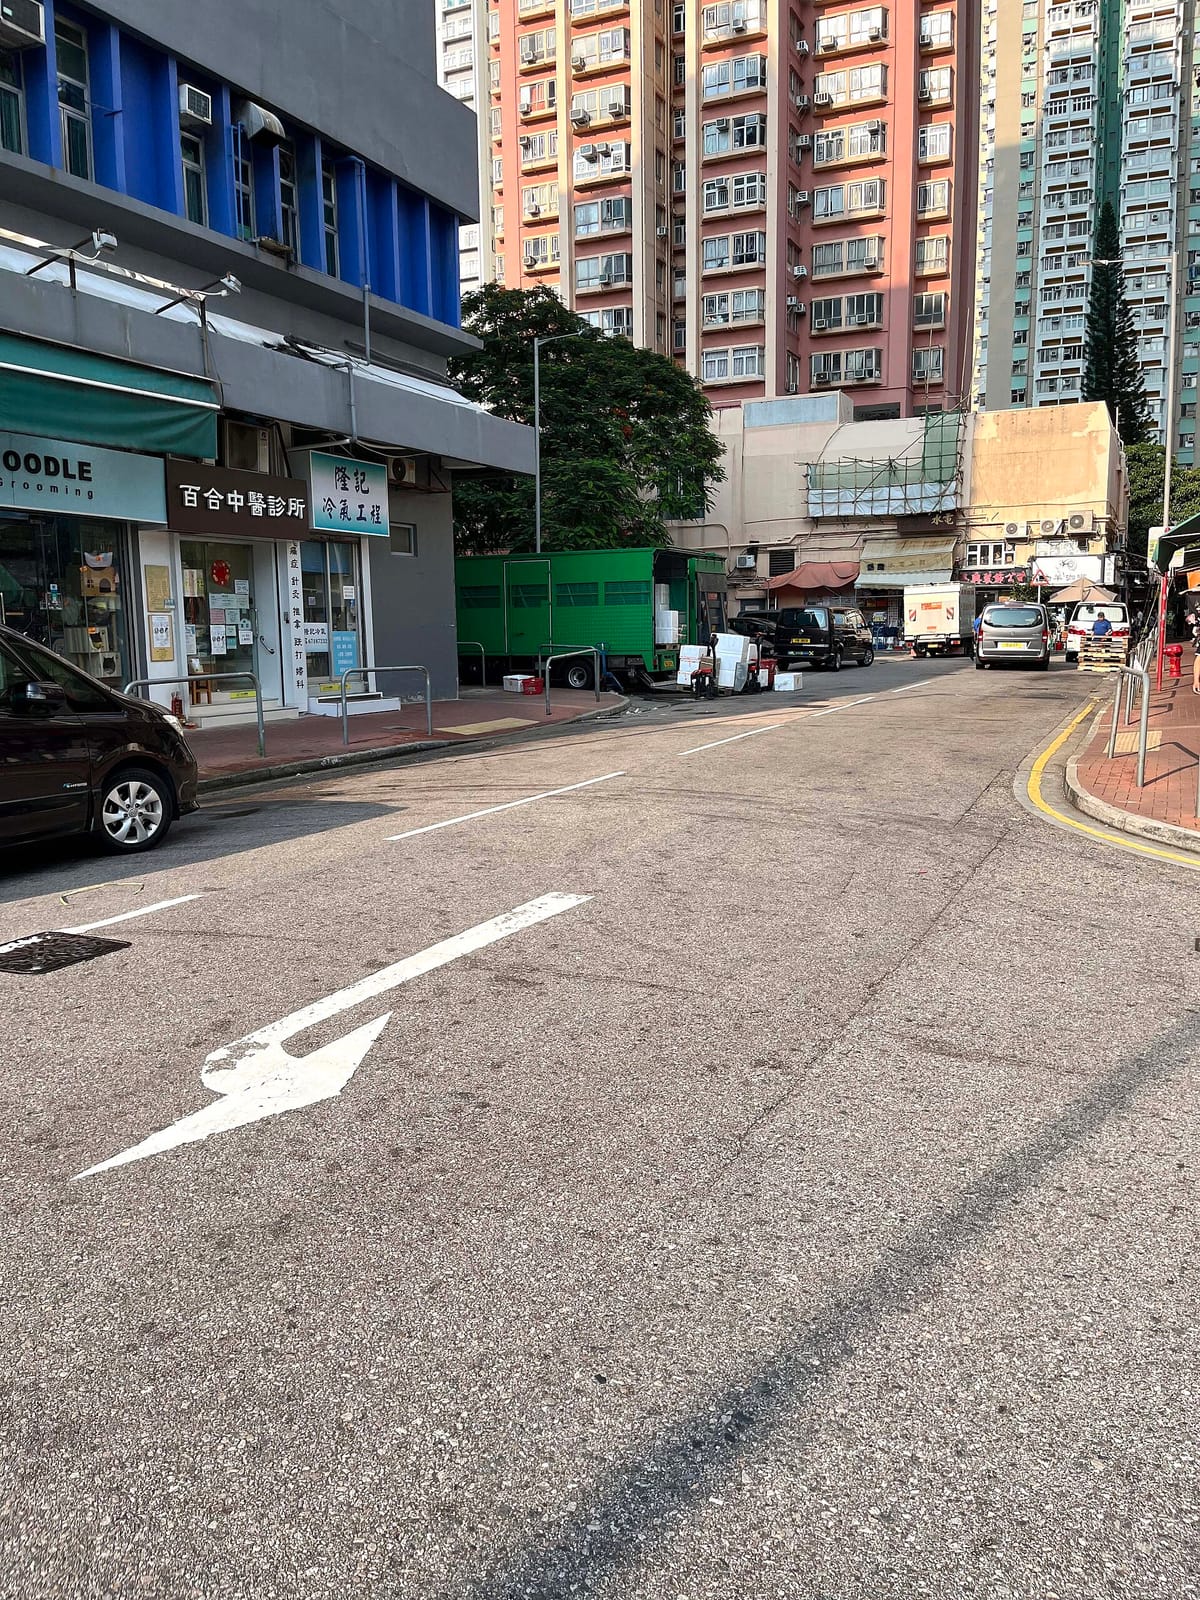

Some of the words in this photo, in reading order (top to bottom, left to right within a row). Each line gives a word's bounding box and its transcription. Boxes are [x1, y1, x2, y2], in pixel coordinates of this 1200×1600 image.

[2, 450, 93, 482] OODLE
[334, 465, 370, 495] 隆記
[179, 484, 306, 520] 百合中醫診所
[322, 497, 382, 525] 冷氣工程
